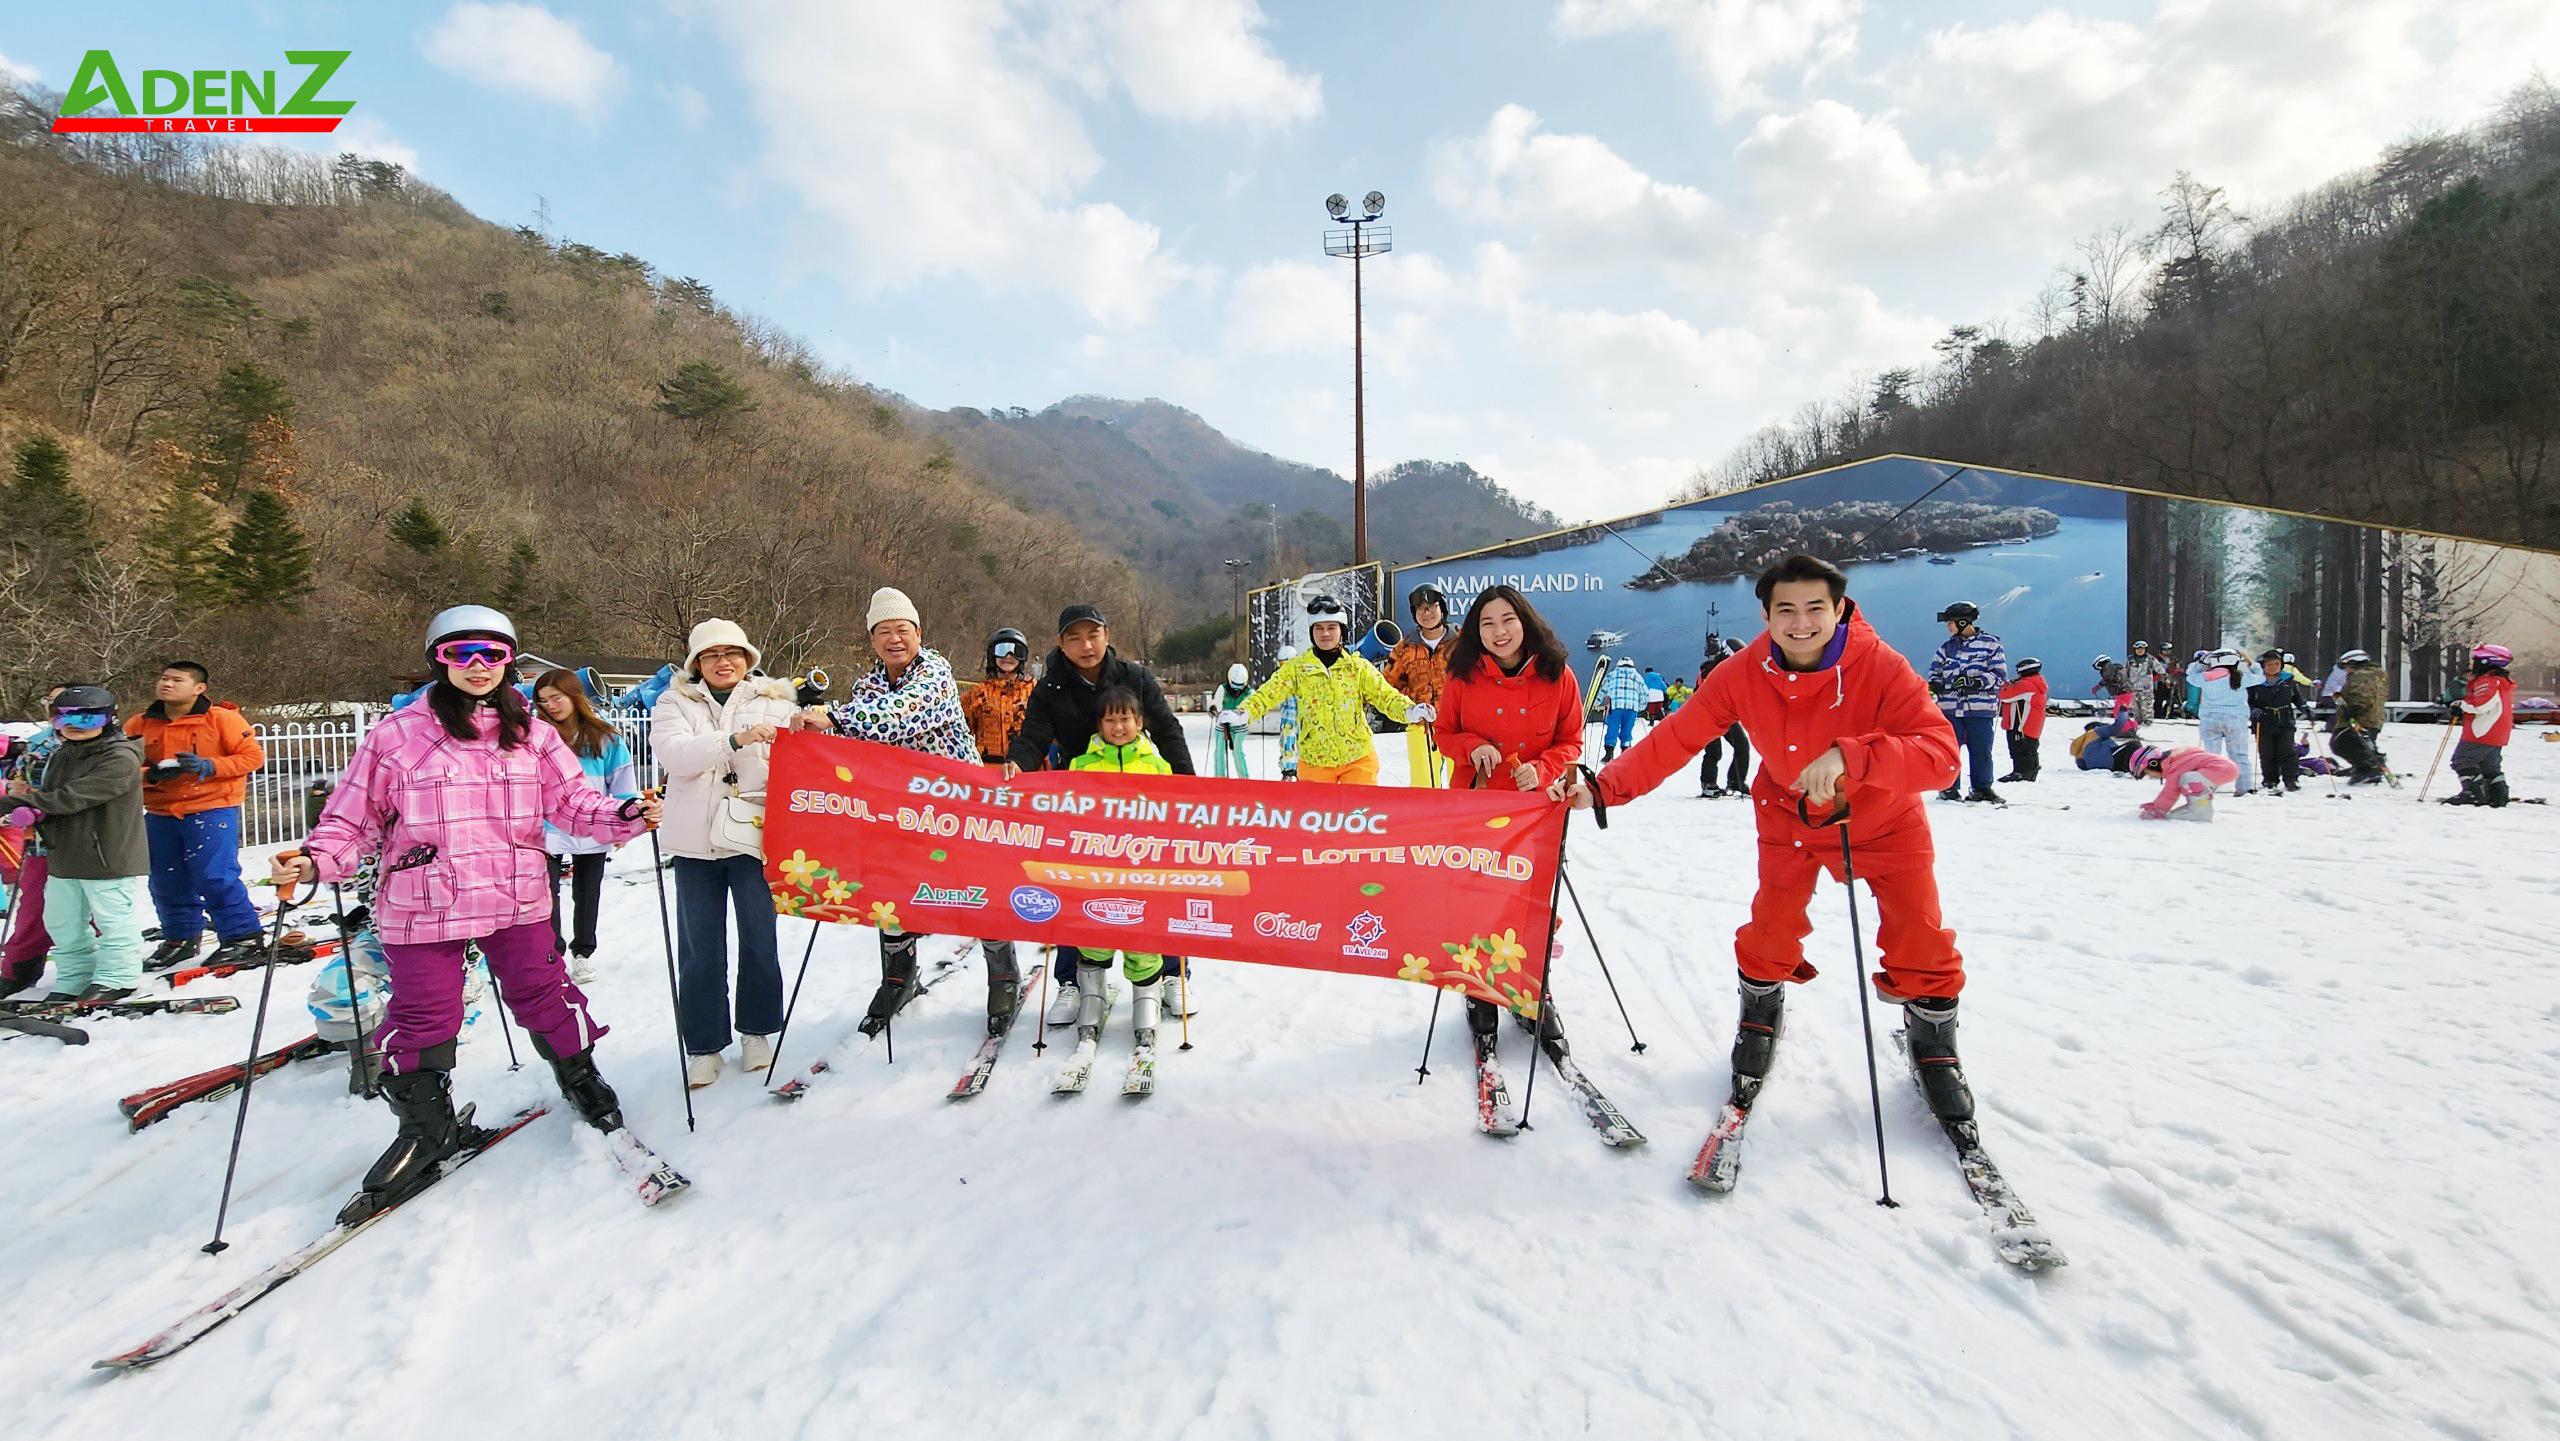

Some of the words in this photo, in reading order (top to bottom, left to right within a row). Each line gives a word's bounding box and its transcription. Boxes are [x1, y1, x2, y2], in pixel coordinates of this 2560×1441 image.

[1437, 575, 1495, 594] NAMI
[1502, 573, 1578, 593] ISLAND
[1584, 572, 1604, 591] in
[908, 775, 971, 801] ĐÓN
[978, 779, 1024, 808] TẾT
[1032, 791, 1096, 817] GIÁP
[1101, 794, 1168, 822] THÌN
[1176, 802, 1219, 829] TẠI
[1227, 802, 1293, 829] HÀN
[1299, 807, 1388, 834] QUỐC
[789, 789, 877, 823] SEOUL
[897, 804, 960, 835] ĐẢO
[963, 816, 1045, 849] NAMI
[1069, 830, 1170, 866] TRƯỢT
[1170, 837, 1272, 866] TUYẾT
[1303, 846, 1406, 865] LOTTE
[1410, 845, 1534, 881] WORLD
[914, 883, 988, 902] ADENZ
